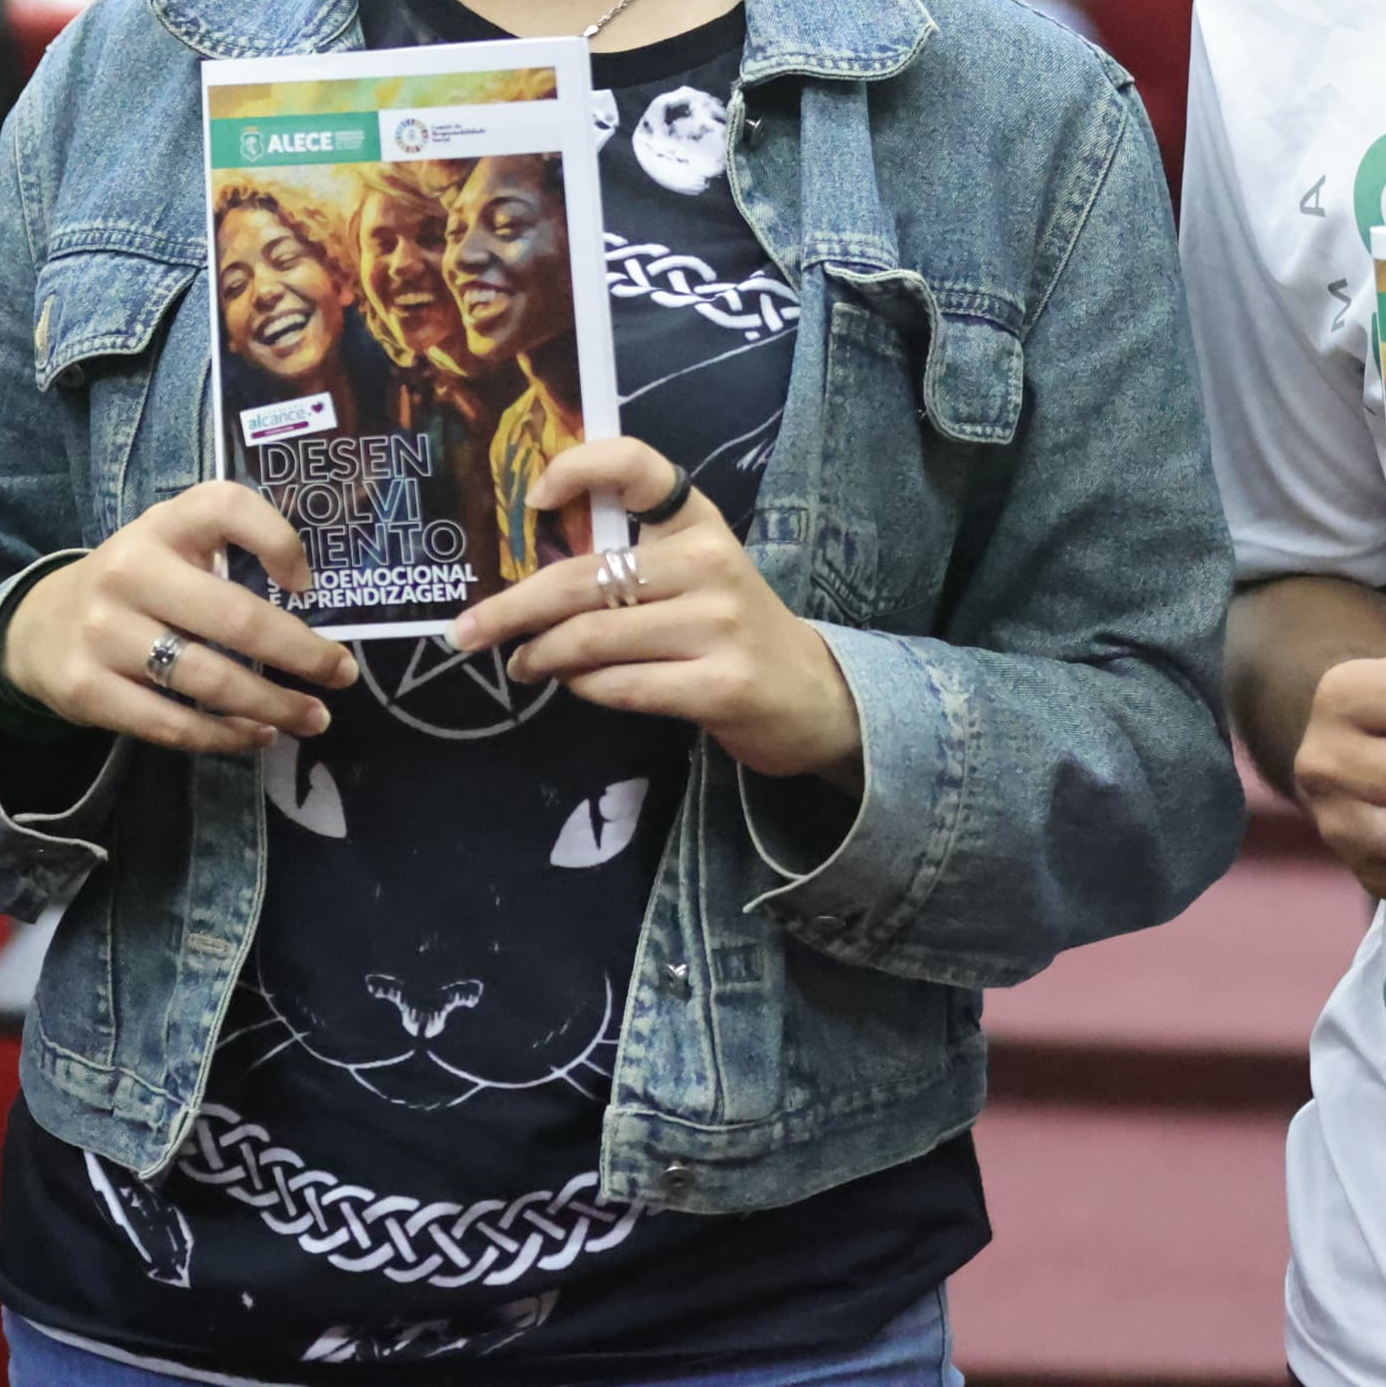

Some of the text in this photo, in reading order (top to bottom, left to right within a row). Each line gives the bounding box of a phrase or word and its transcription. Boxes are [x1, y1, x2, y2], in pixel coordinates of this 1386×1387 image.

[267, 131, 333, 154] ALECE
[259, 433, 432, 486] DESEN
[286, 583, 467, 611] APRENDIZAGEM
